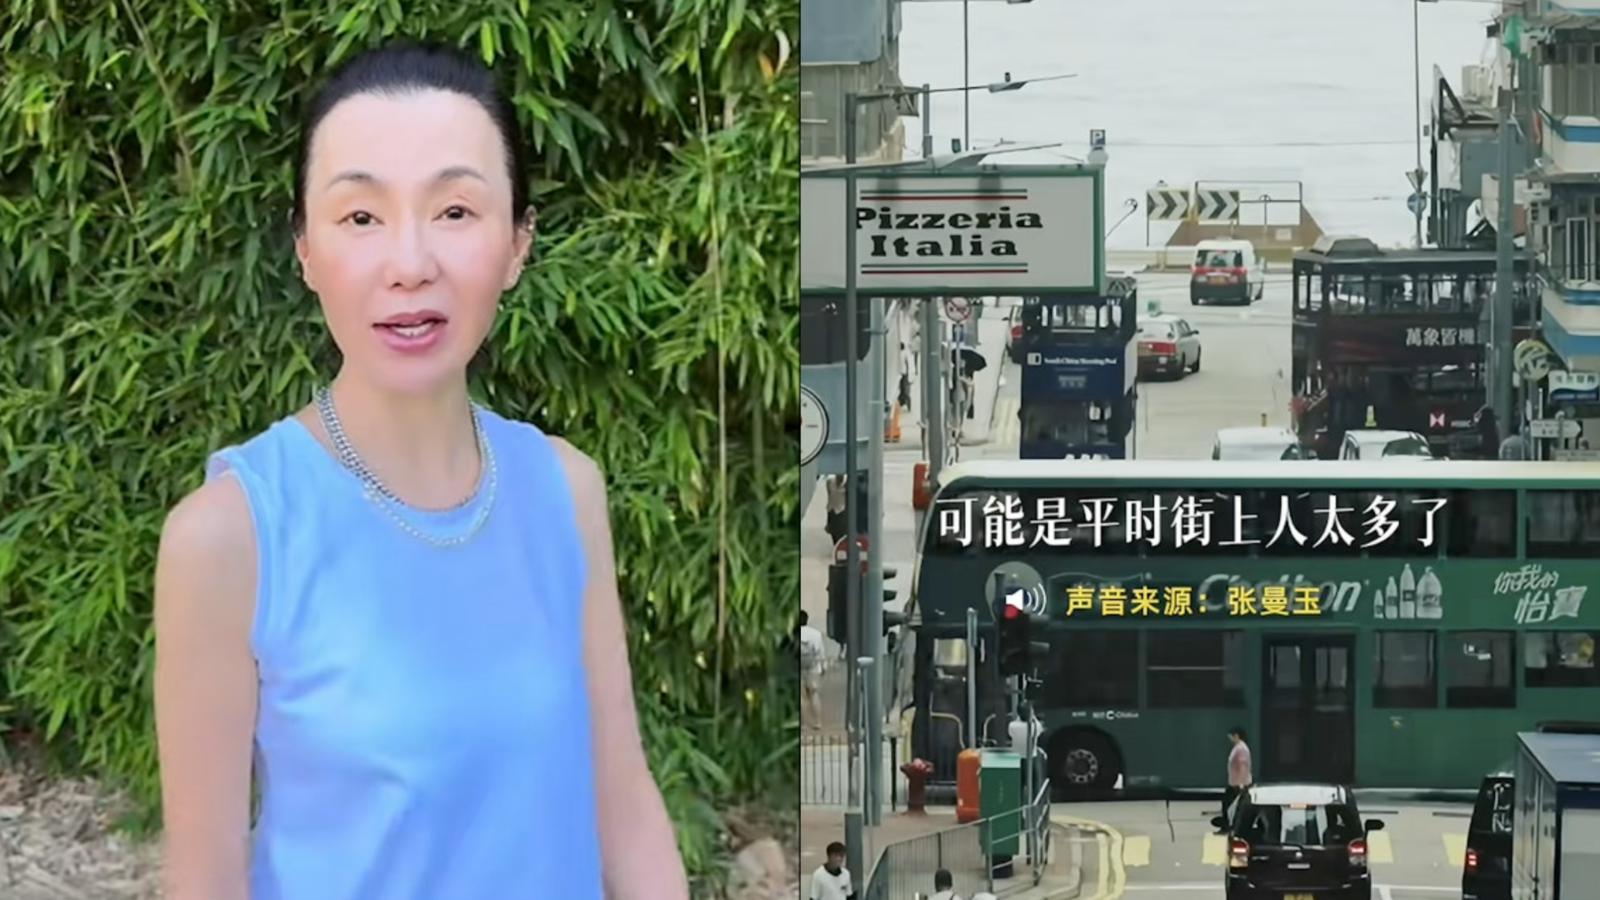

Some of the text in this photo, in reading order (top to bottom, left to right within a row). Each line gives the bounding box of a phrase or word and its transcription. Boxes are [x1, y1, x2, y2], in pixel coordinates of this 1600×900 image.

[856, 206, 1043, 230] Pizzeria
[871, 234, 1018, 257] Italia
[1493, 564, 1560, 595] 你我的
